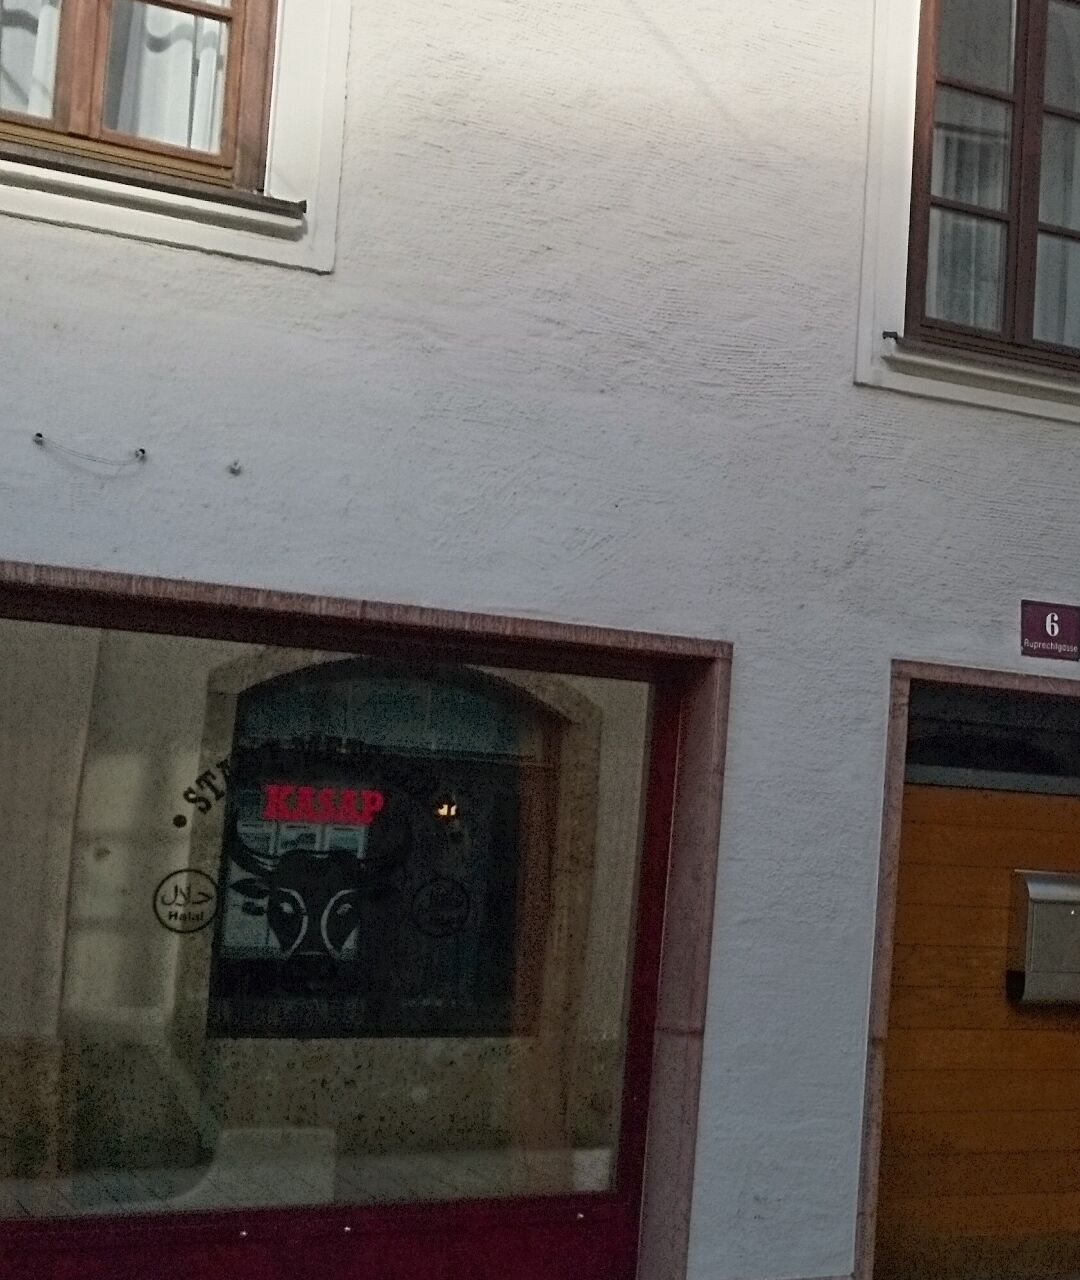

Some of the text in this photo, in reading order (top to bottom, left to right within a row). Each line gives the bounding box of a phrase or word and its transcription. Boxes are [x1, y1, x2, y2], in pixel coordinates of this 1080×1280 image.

[1045, 612, 1059, 637] 6
[1023, 638, 1078, 653] Ruprechtgasse
[264, 783, 384, 825] KASAP
[160, 885, 214, 908] حلال
[167, 910, 204, 922] Halal
